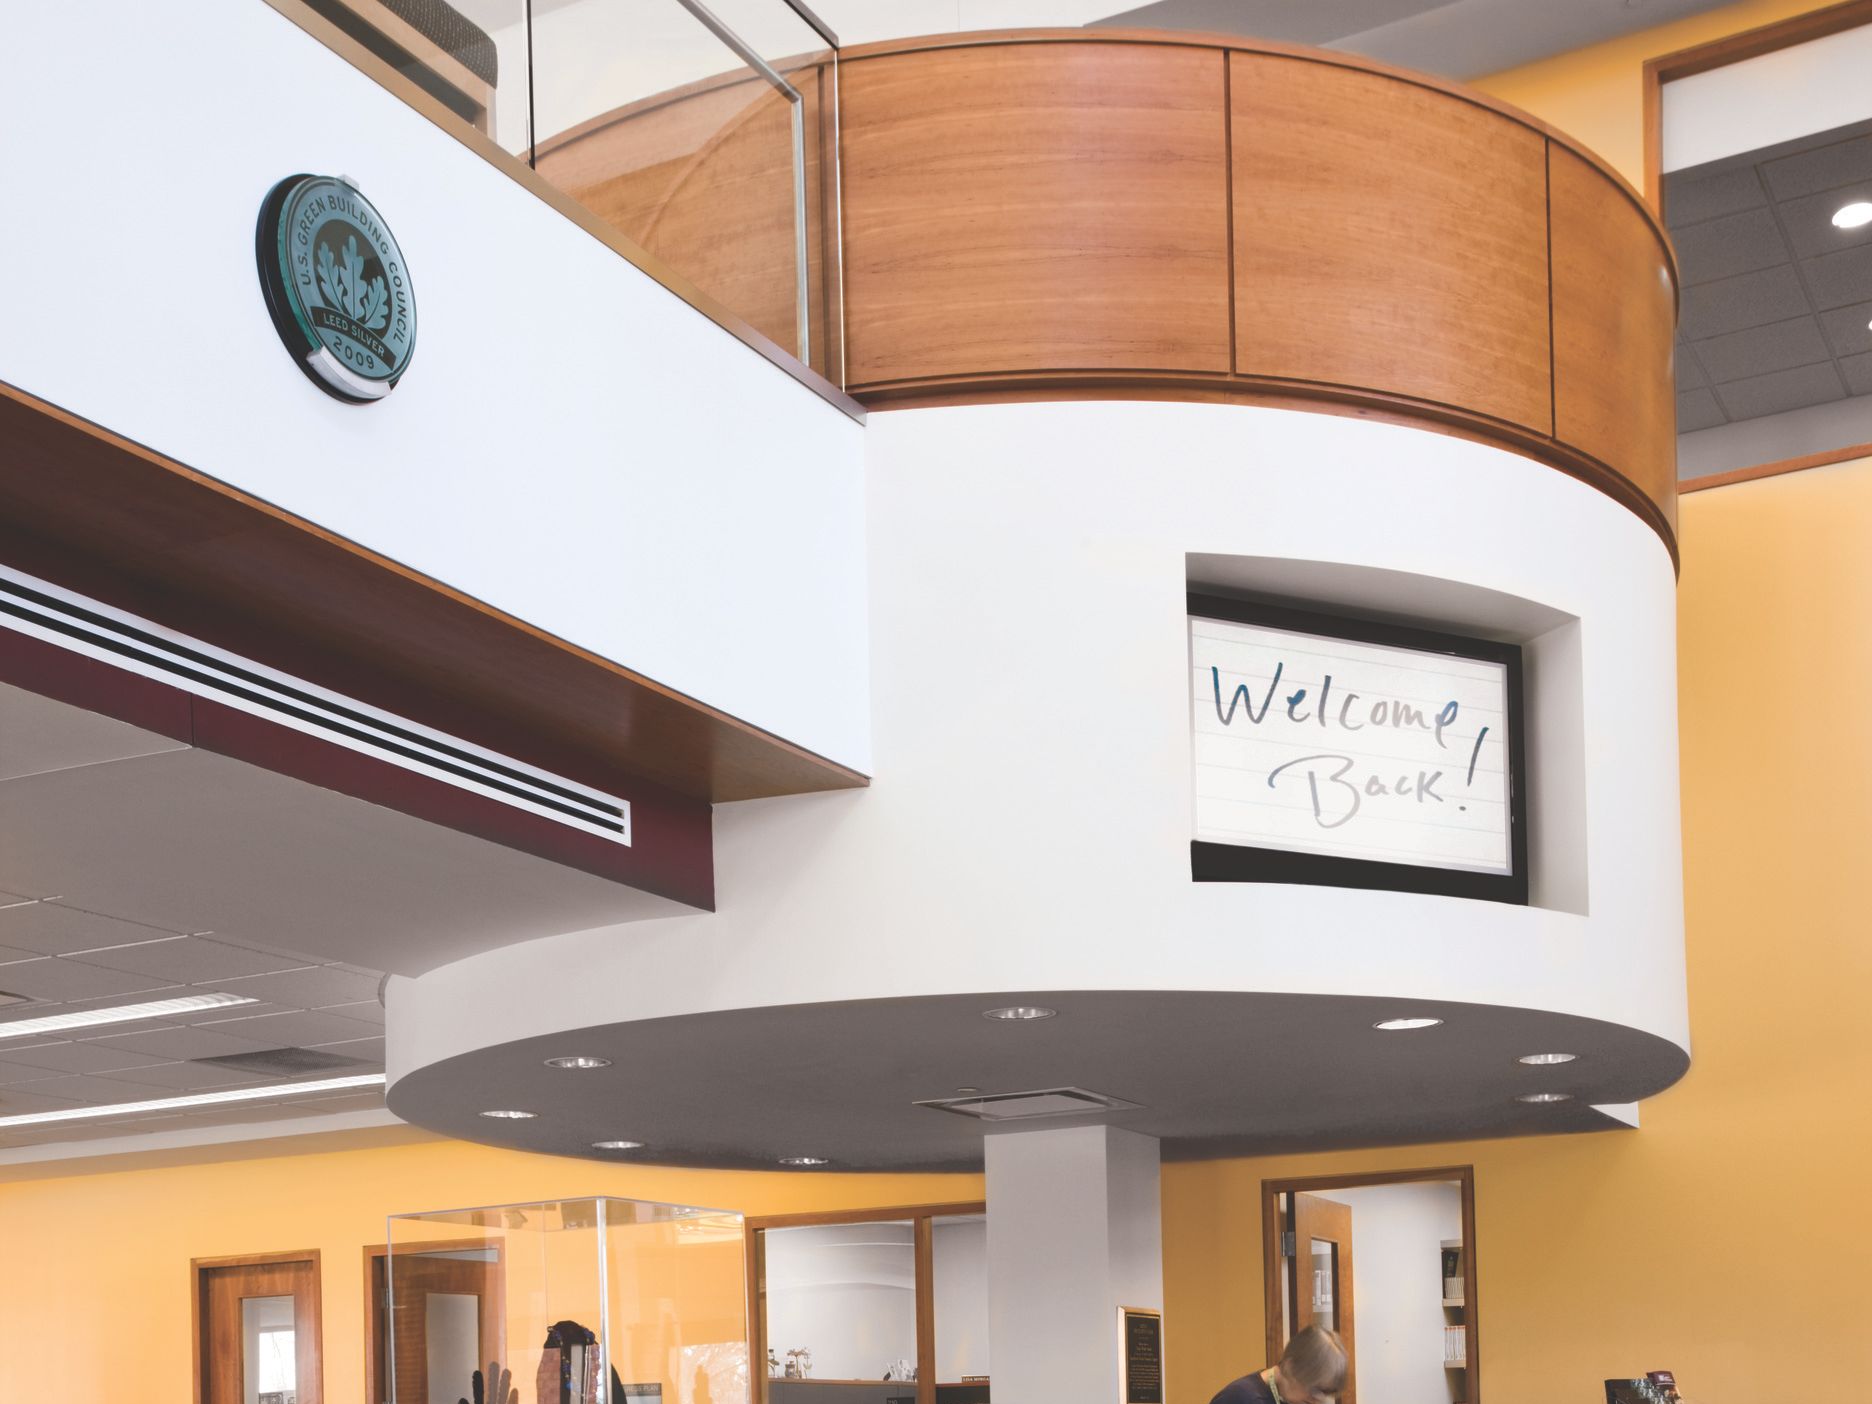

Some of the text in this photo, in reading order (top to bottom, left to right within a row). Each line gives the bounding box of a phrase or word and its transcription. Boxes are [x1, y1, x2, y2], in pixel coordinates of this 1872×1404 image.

[297, 195, 406, 344] U.S. GREEN BUILDING COUNCIL
[323, 312, 385, 357] LEED SILVER
[332, 336, 375, 369] 2009
[1211, 661, 1460, 749] Welcome
[1267, 726, 1490, 829] Back!
